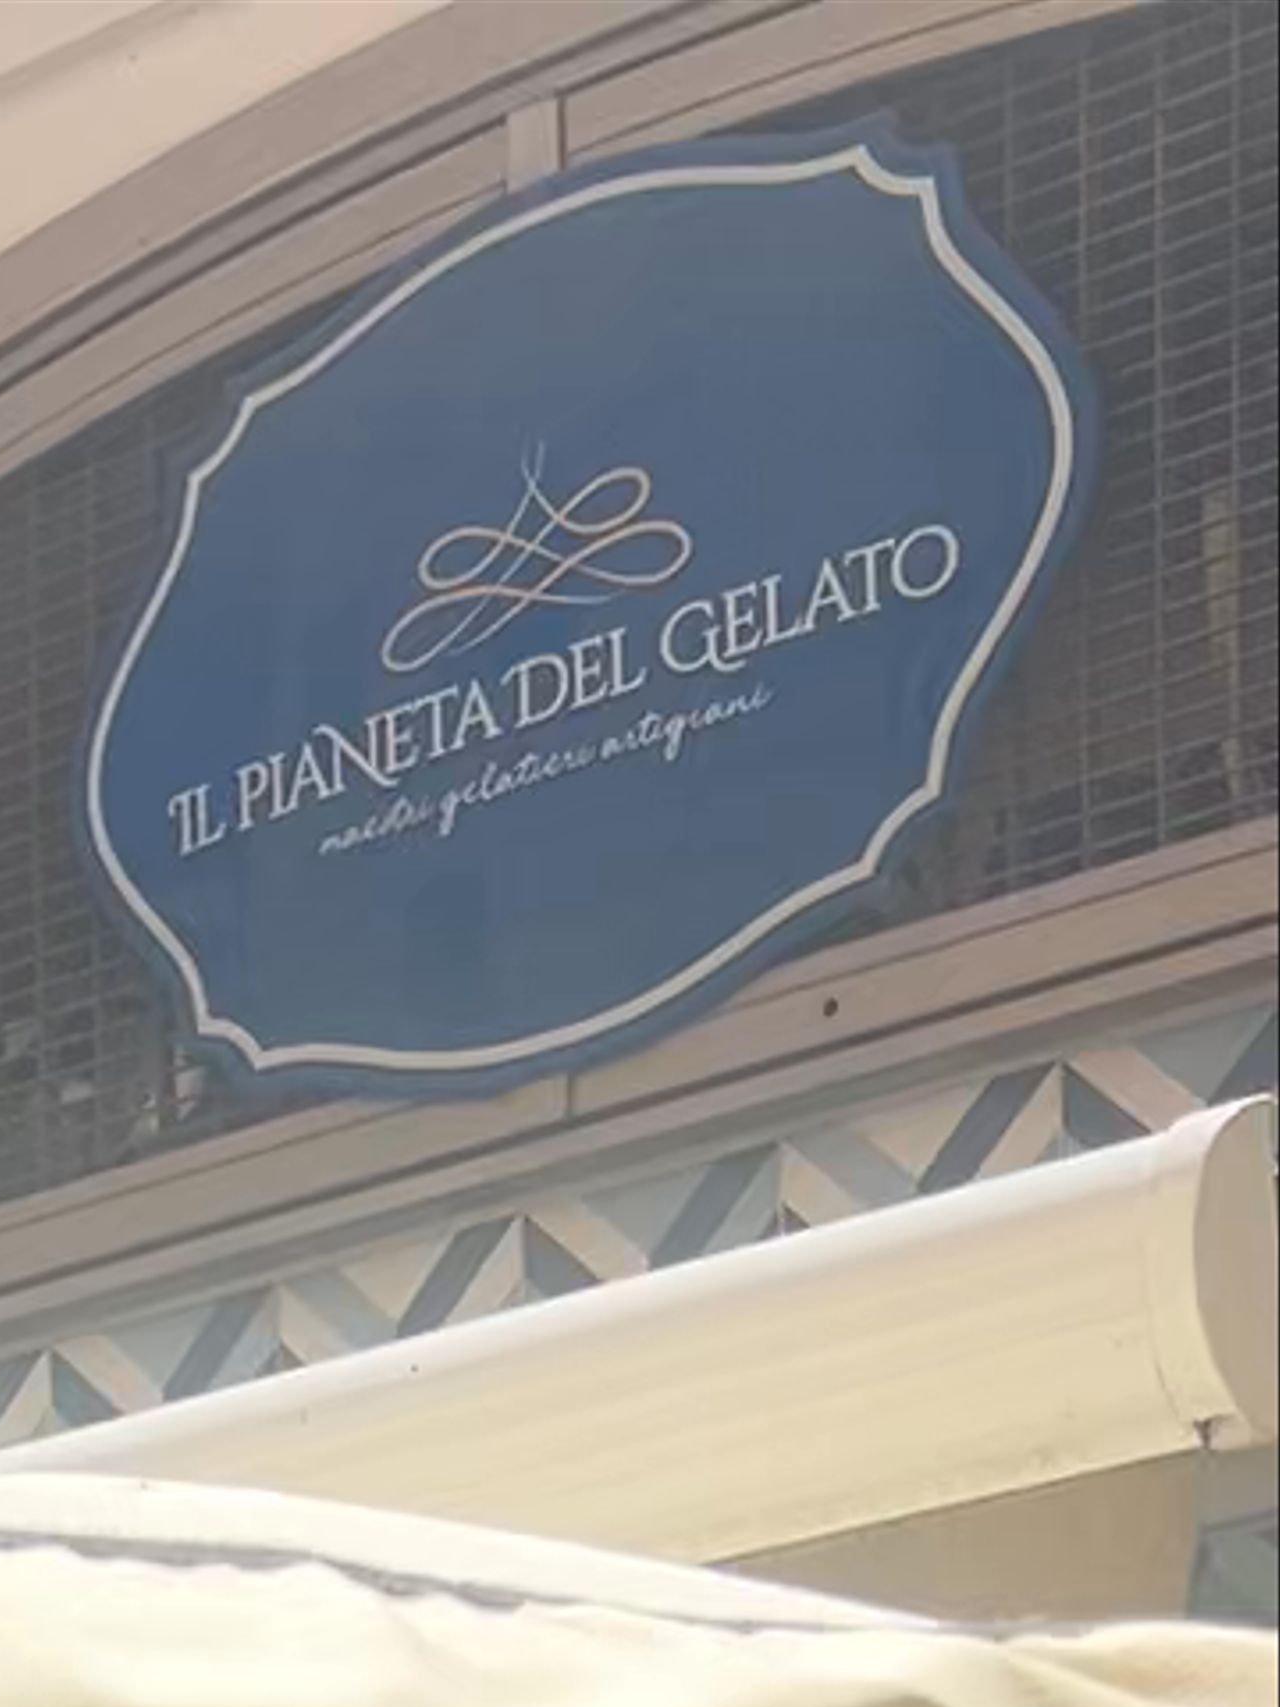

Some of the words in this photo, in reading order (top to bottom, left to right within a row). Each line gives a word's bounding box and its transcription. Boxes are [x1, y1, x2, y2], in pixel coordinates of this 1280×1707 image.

[169, 788, 226, 857] IL
[237, 679, 502, 830] PIANETA
[501, 626, 646, 730] DEL
[660, 524, 959, 671] GELATO
[439, 745, 592, 836] gelatieri
[601, 682, 774, 761] artigiani
